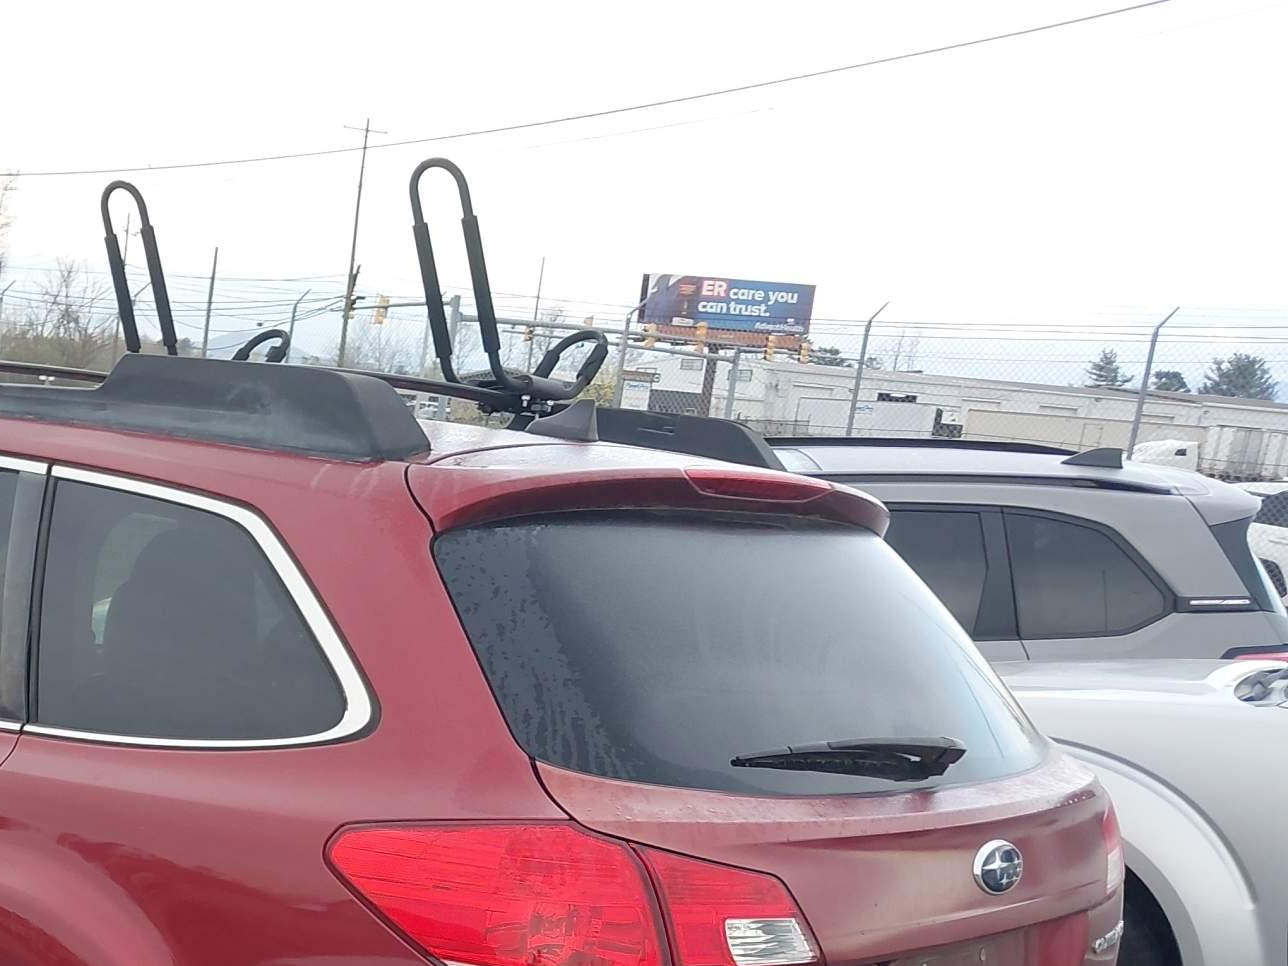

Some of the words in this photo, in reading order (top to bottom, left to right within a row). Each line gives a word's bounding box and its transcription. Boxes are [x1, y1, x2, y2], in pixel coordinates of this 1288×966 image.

[701, 279, 728, 297] ER
[729, 288, 765, 301] care
[767, 290, 799, 305] you
[697, 301, 728, 314] can
[729, 301, 770, 317] trust.
